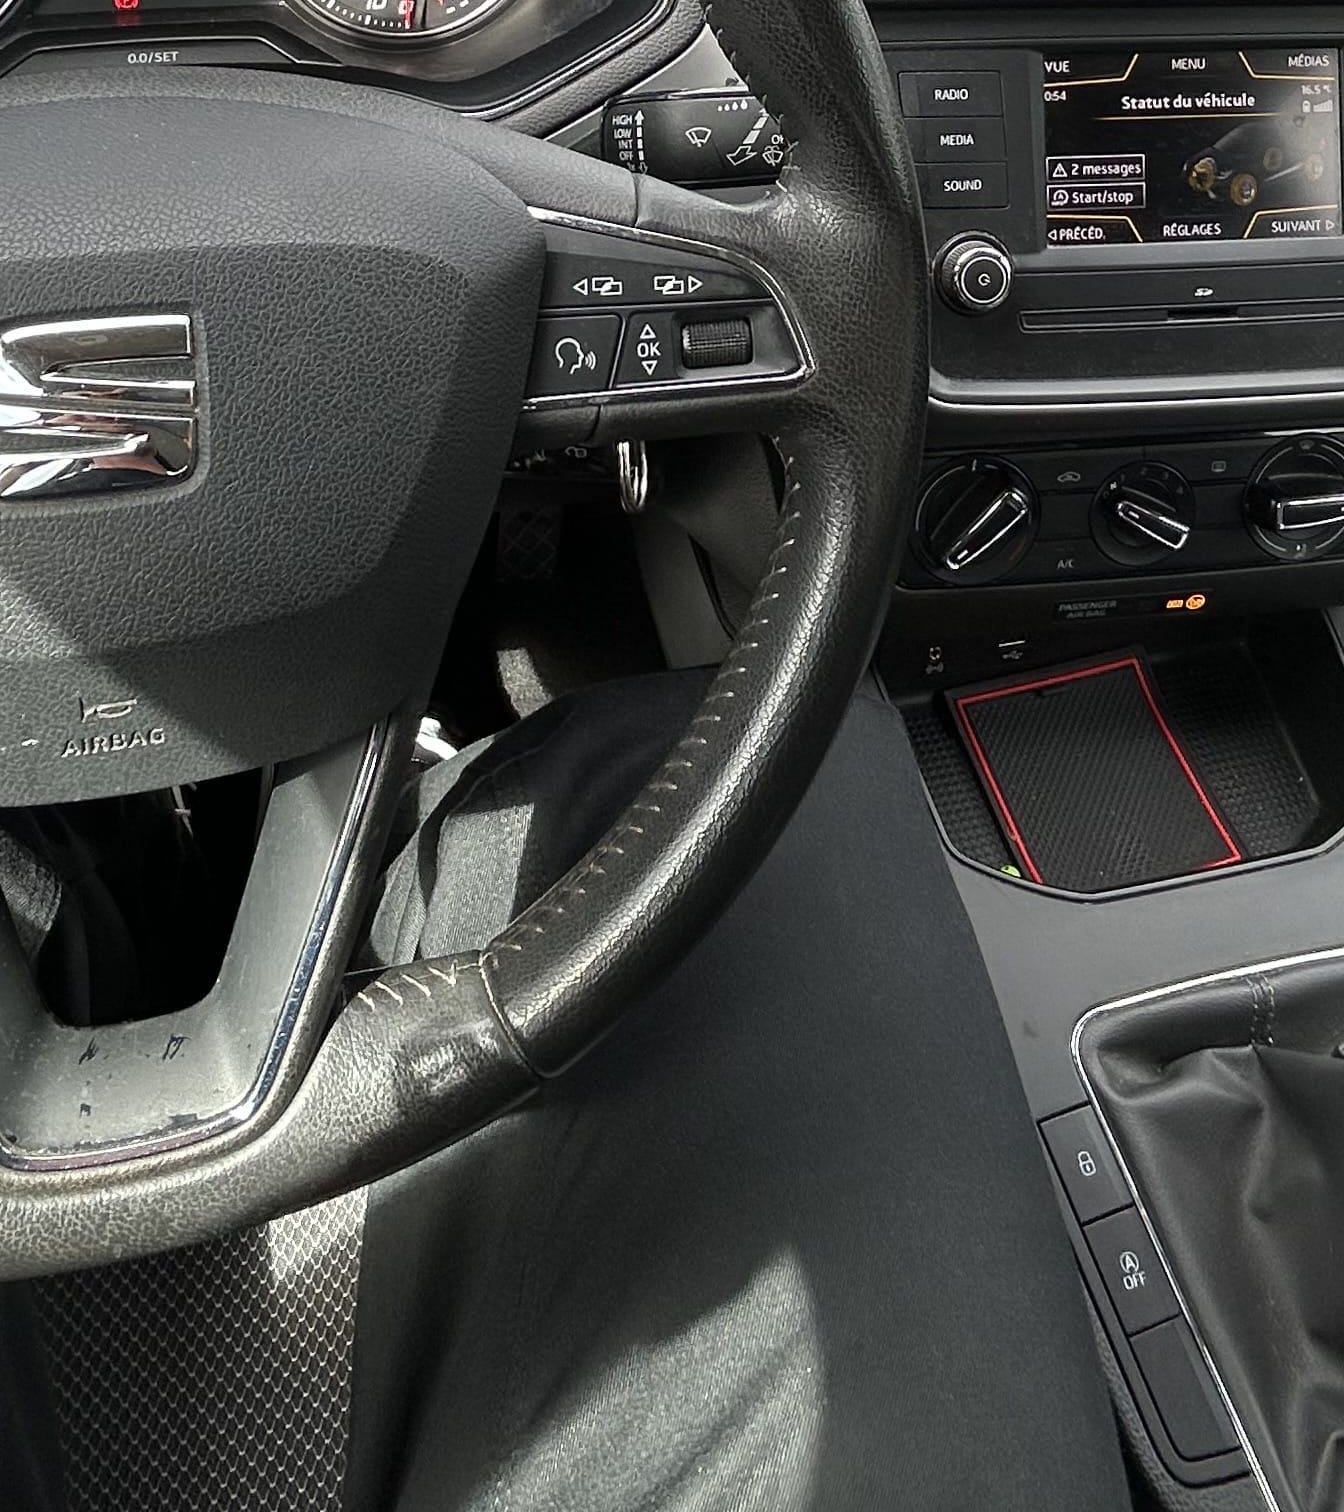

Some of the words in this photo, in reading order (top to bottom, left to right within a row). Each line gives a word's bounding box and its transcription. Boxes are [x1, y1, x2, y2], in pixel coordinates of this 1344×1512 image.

[127, 51, 179, 64] 0.0/SET
[1288, 53, 1330, 67] MÉDIAS
[1044, 60, 1070, 73] VUE
[1171, 58, 1206, 71] MENU
[934, 89, 969, 101] RADIO
[1121, 96, 1170, 110] Statut
[1172, 94, 1192, 108] du
[1195, 92, 1256, 108] véhicule
[612, 114, 633, 126] HIGH
[613, 128, 631, 139] LOW
[940, 133, 974, 146] MEDIA
[618, 139, 633, 150] INT
[619, 150, 633, 161] OFF
[1071, 164, 1079, 176] 2
[1083, 162, 1141, 177] messages
[943, 178, 982, 192] SOUND
[1072, 190, 1133, 205] Start/stop
[1163, 223, 1222, 237] RÉGLAGES
[1271, 219, 1321, 234] SUIVANT
[637, 341, 661, 357] OK
[1057, 559, 1075, 569] A/C
[61, 728, 166, 758] AIRBAG
[1122, 1271, 1146, 1290] OFF
